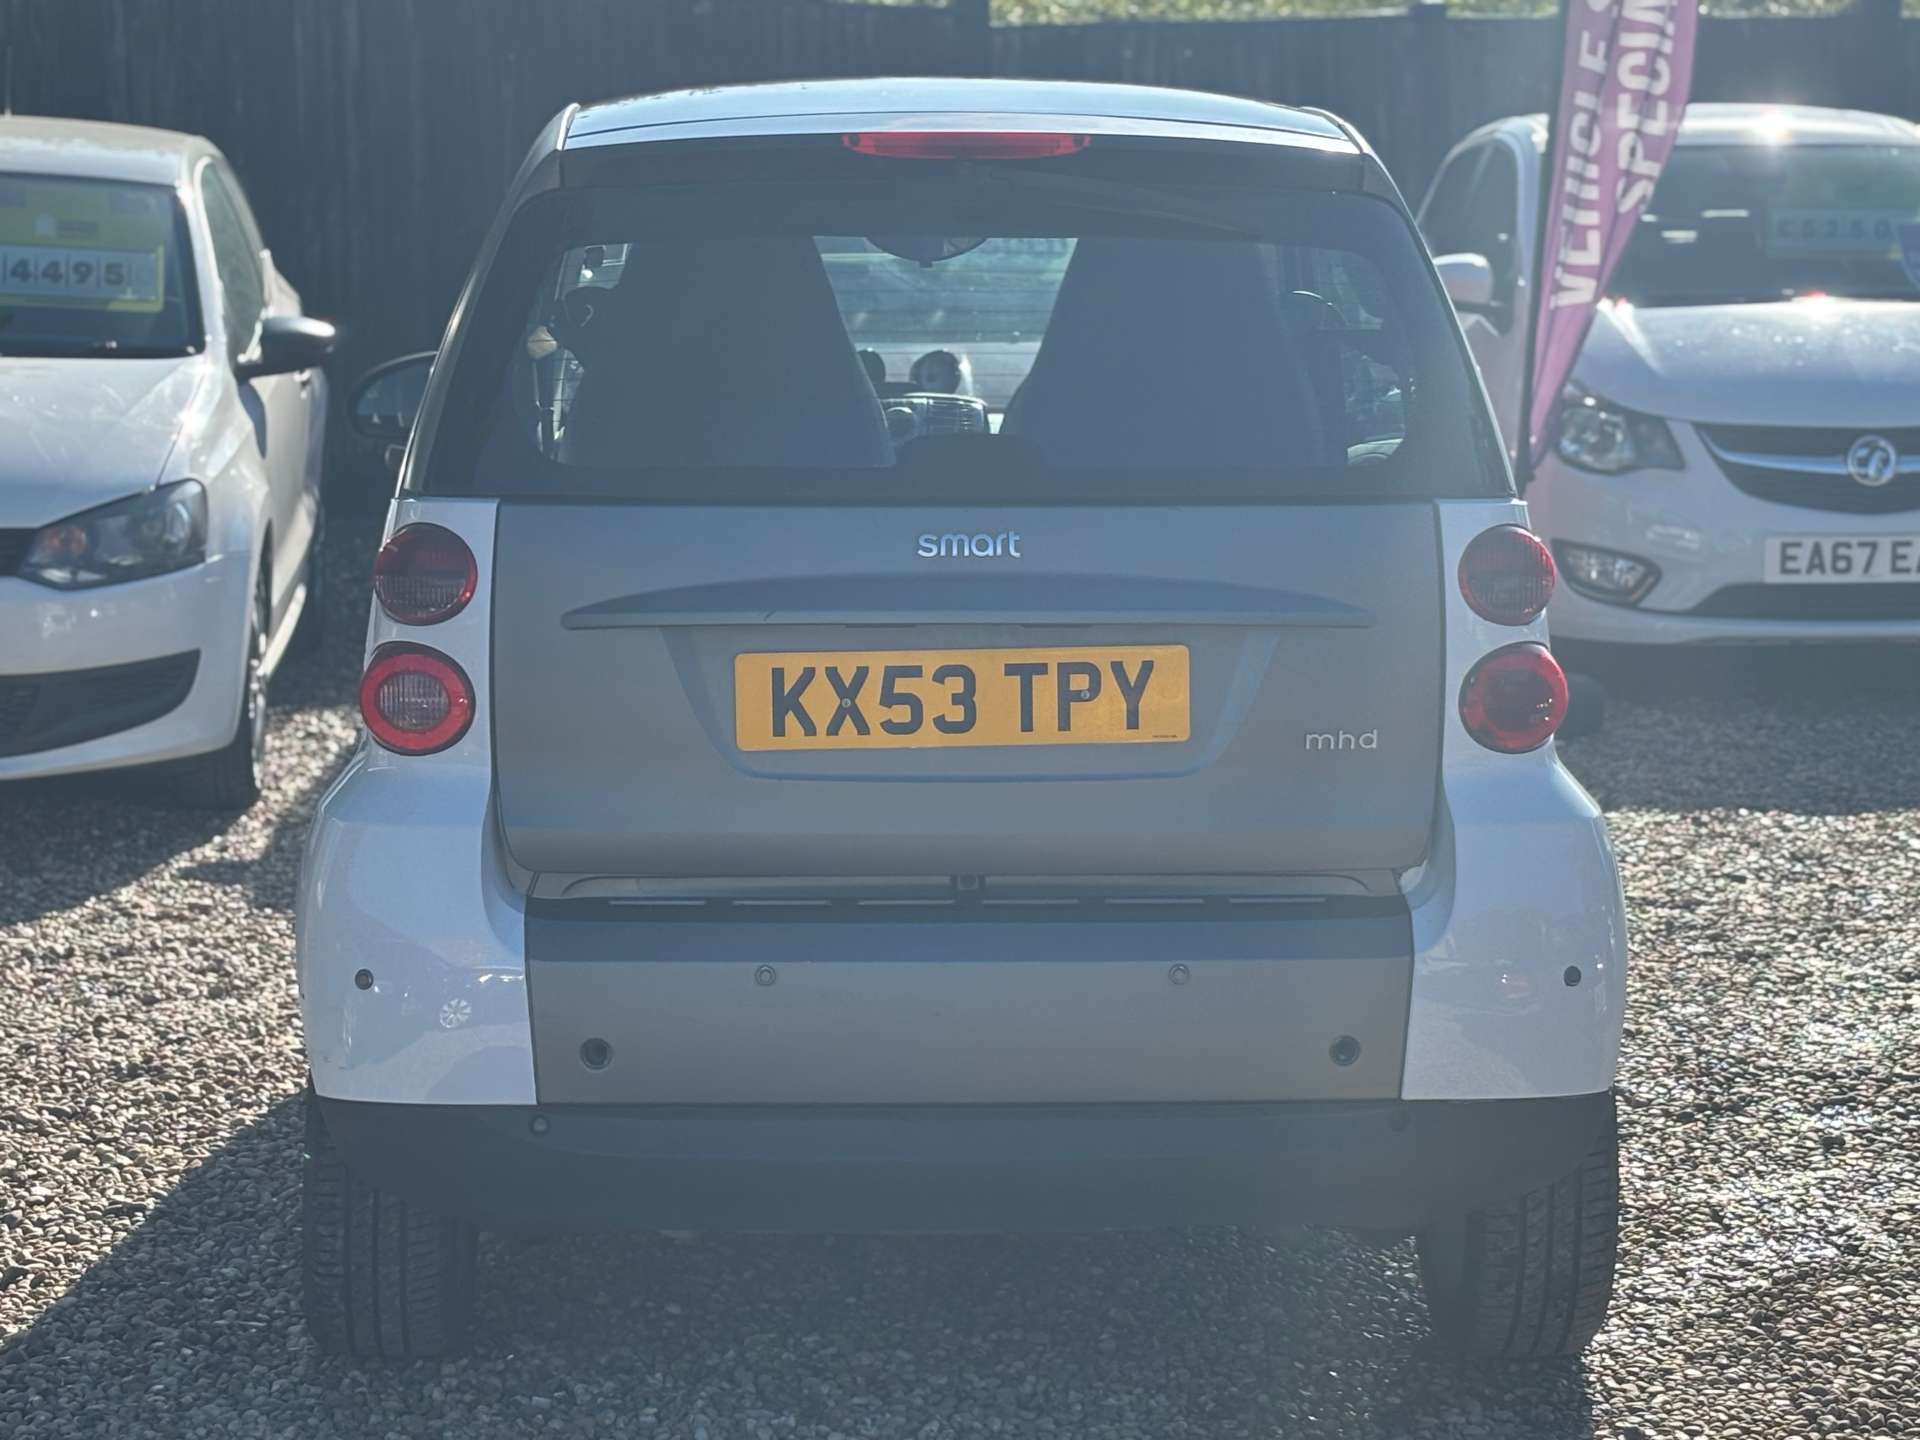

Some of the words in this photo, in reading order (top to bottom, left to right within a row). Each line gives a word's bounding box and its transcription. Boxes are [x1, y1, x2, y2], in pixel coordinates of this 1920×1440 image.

[917, 531, 1021, 558] smart
[1779, 541, 1879, 575] EA67
[1890, 540, 1920, 574] E
[771, 664, 977, 737] KX53
[1004, 660, 1154, 732] TPY
[1305, 728, 1377, 750] mhd
